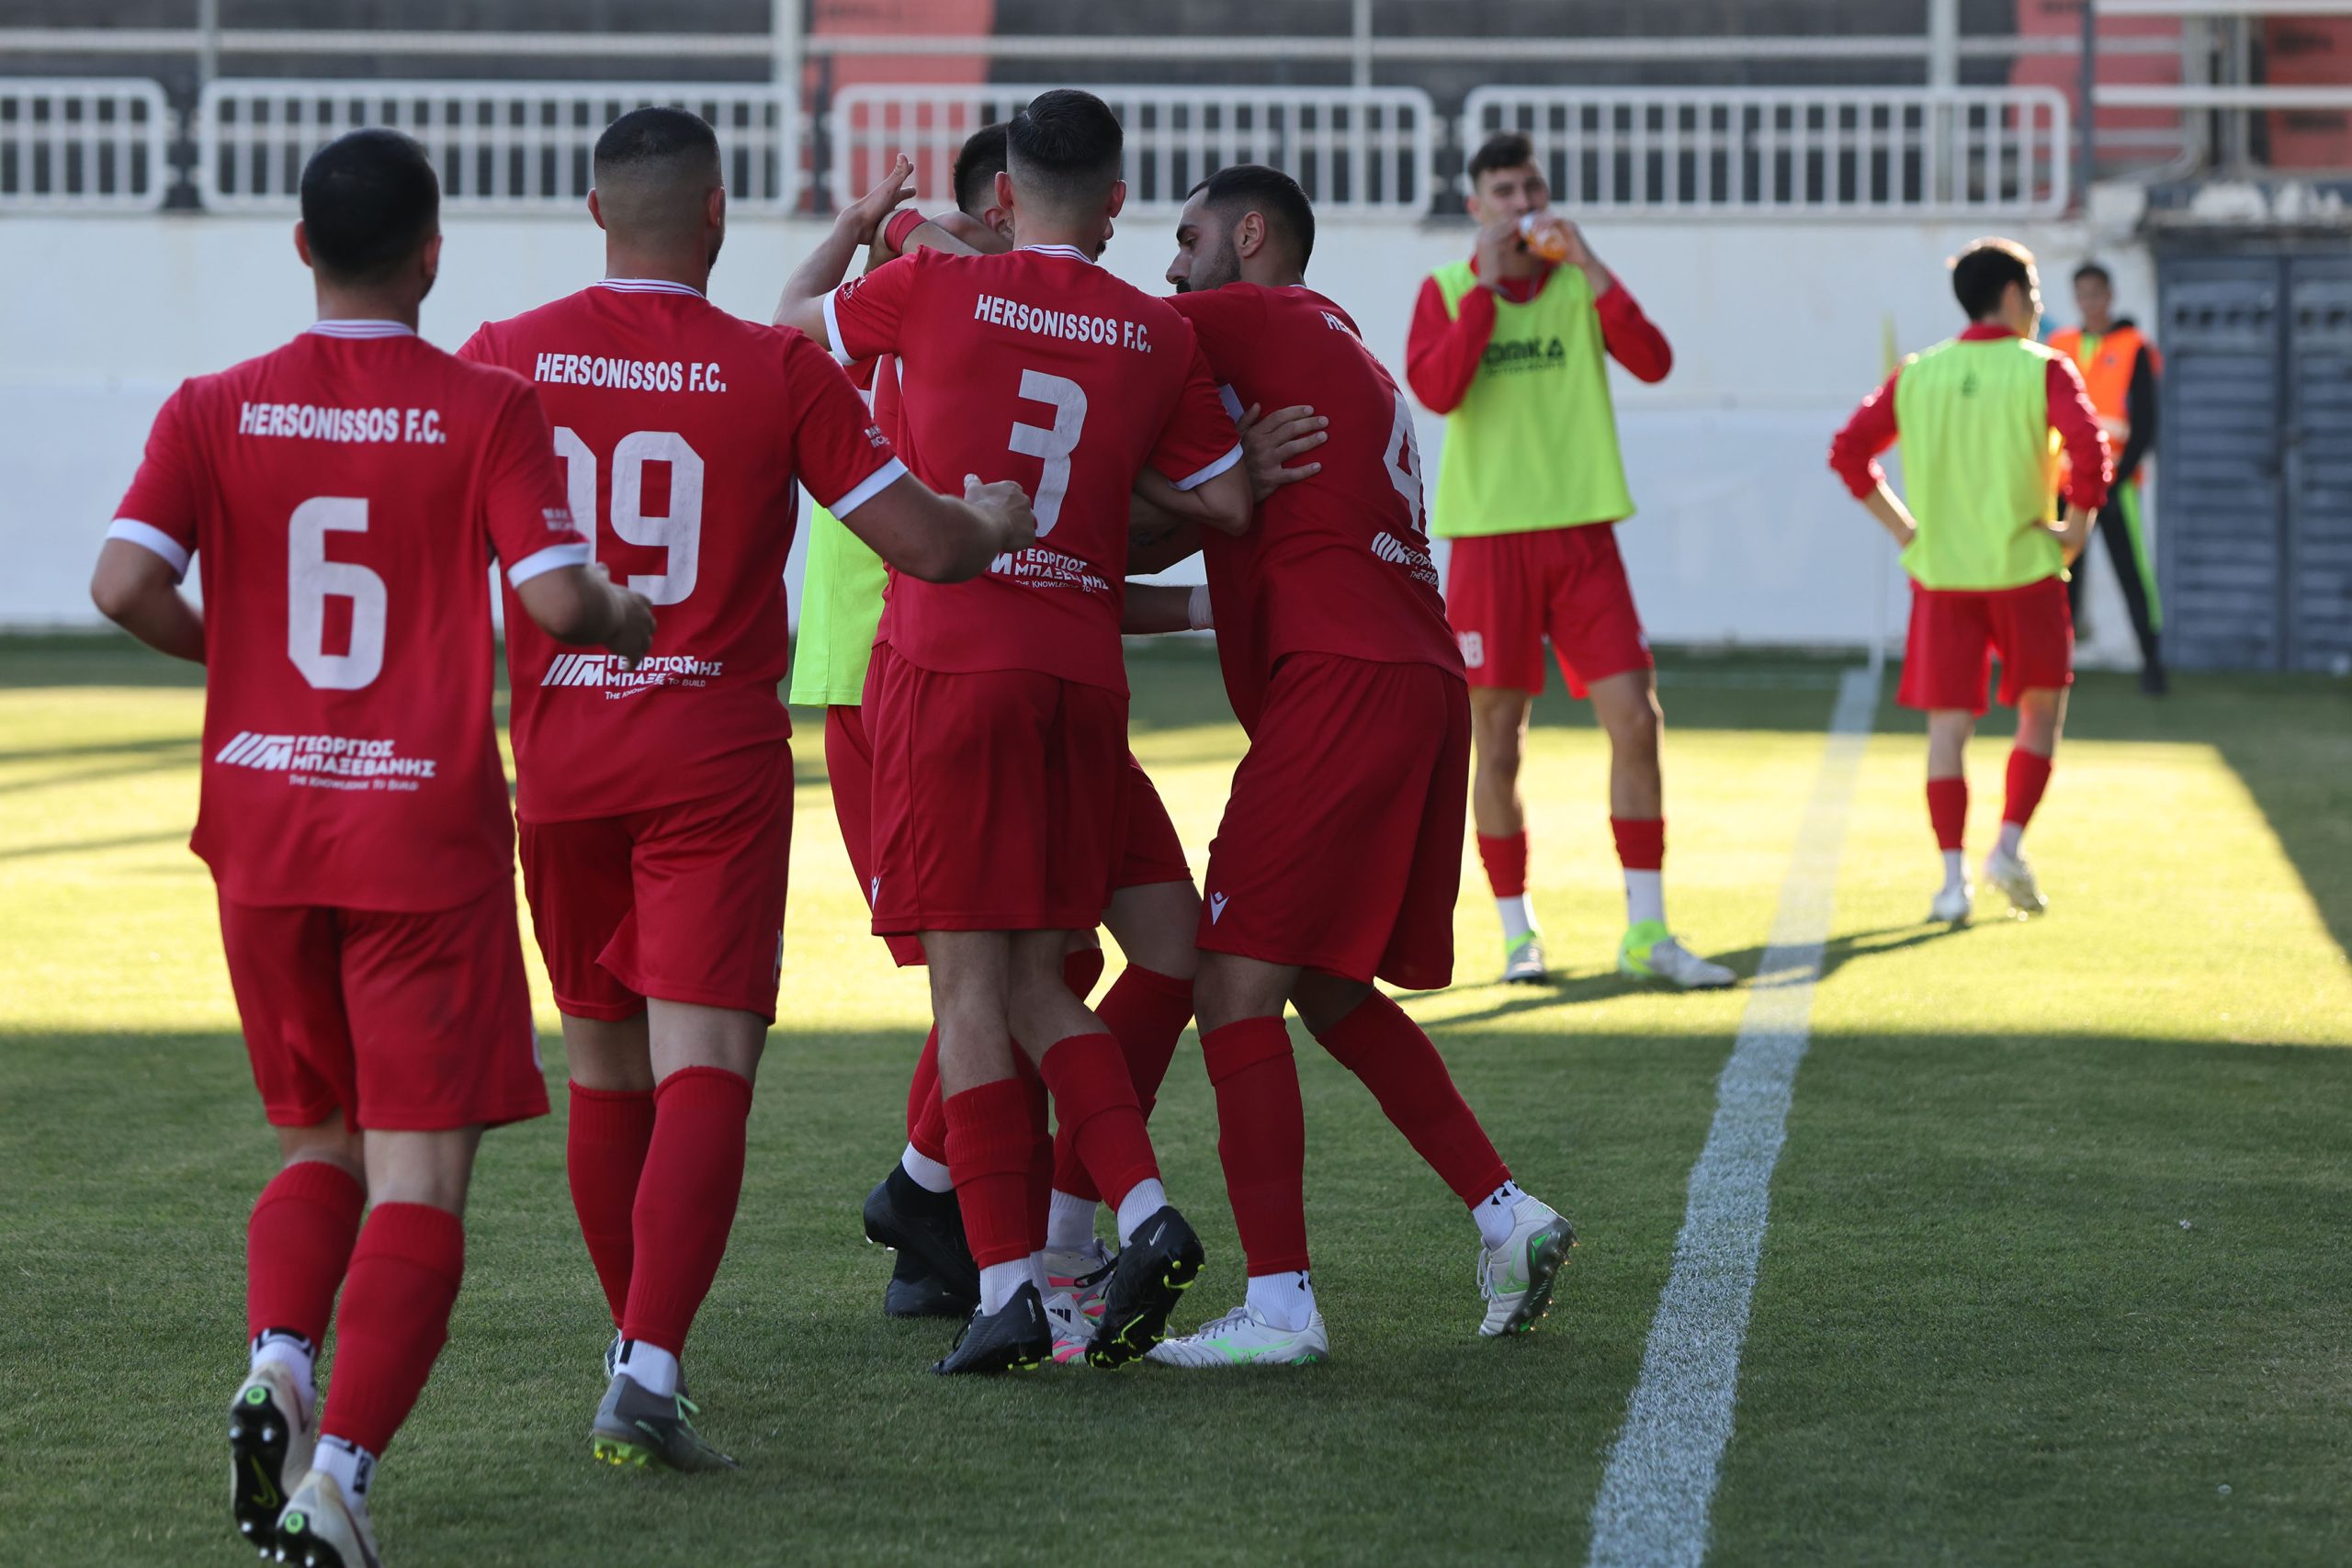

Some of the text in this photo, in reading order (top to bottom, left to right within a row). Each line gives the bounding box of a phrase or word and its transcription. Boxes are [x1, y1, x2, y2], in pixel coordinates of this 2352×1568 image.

[975, 294, 1152, 353] HERSONISSOS F.C.
[534, 352, 727, 392] HERSONISSOS F.C.
[239, 401, 447, 445] HERSONISSOS F.C.
[1008, 368, 1088, 537] 3
[1383, 388, 1425, 534] 4
[288, 496, 388, 691] 6
[605, 691, 620, 700] THE
[683, 679, 706, 687] BUILD
[290, 754, 436, 778] ΜΠΑΞΕΒΑΝΗΣ
[294, 735, 395, 758] ΓΕΩΡΓΙΟΣ
